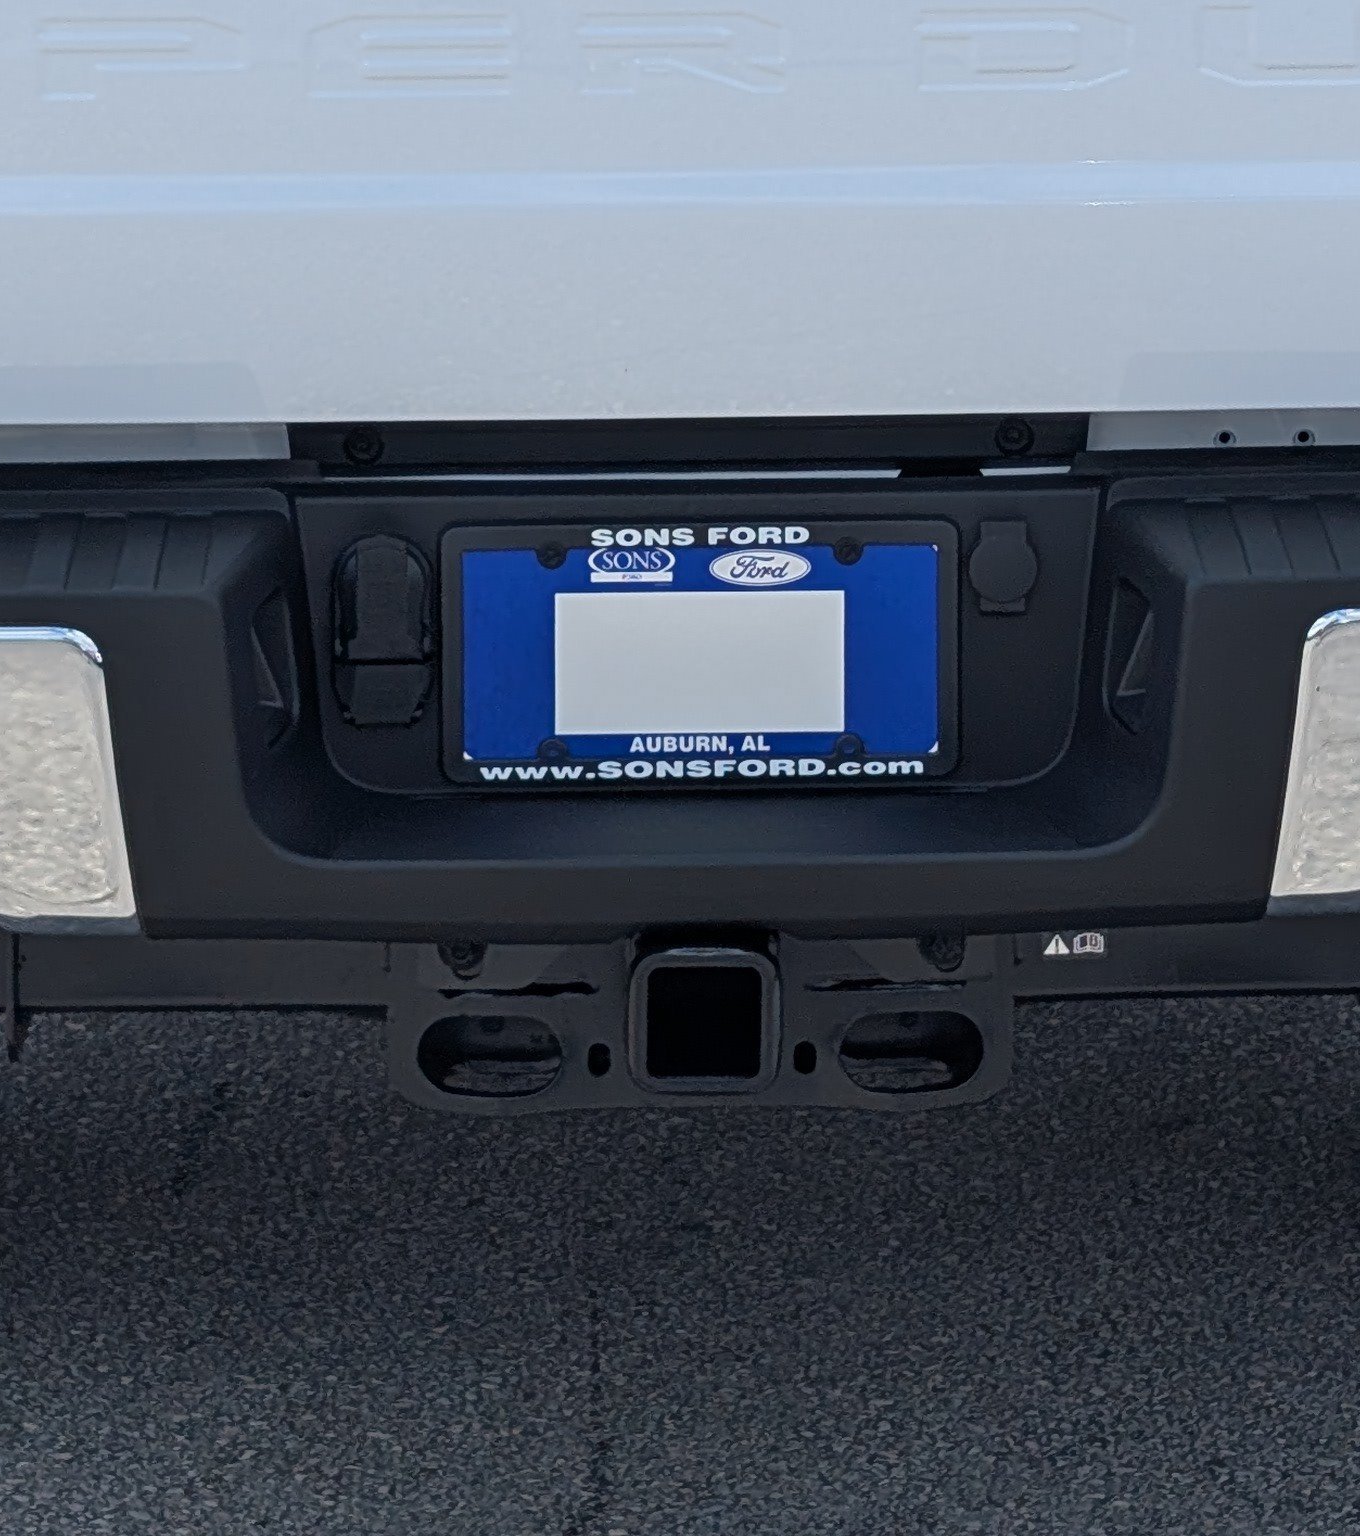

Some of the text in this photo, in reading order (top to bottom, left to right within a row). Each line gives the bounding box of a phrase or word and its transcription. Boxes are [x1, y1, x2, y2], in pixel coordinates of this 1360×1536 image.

[590, 526, 810, 547] SONS FORD
[601, 551, 662, 570] SONS
[730, 555, 790, 579] Ford
[629, 735, 771, 755] AUBURN, AL
[479, 758, 924, 781] www.SONSFORD.com
